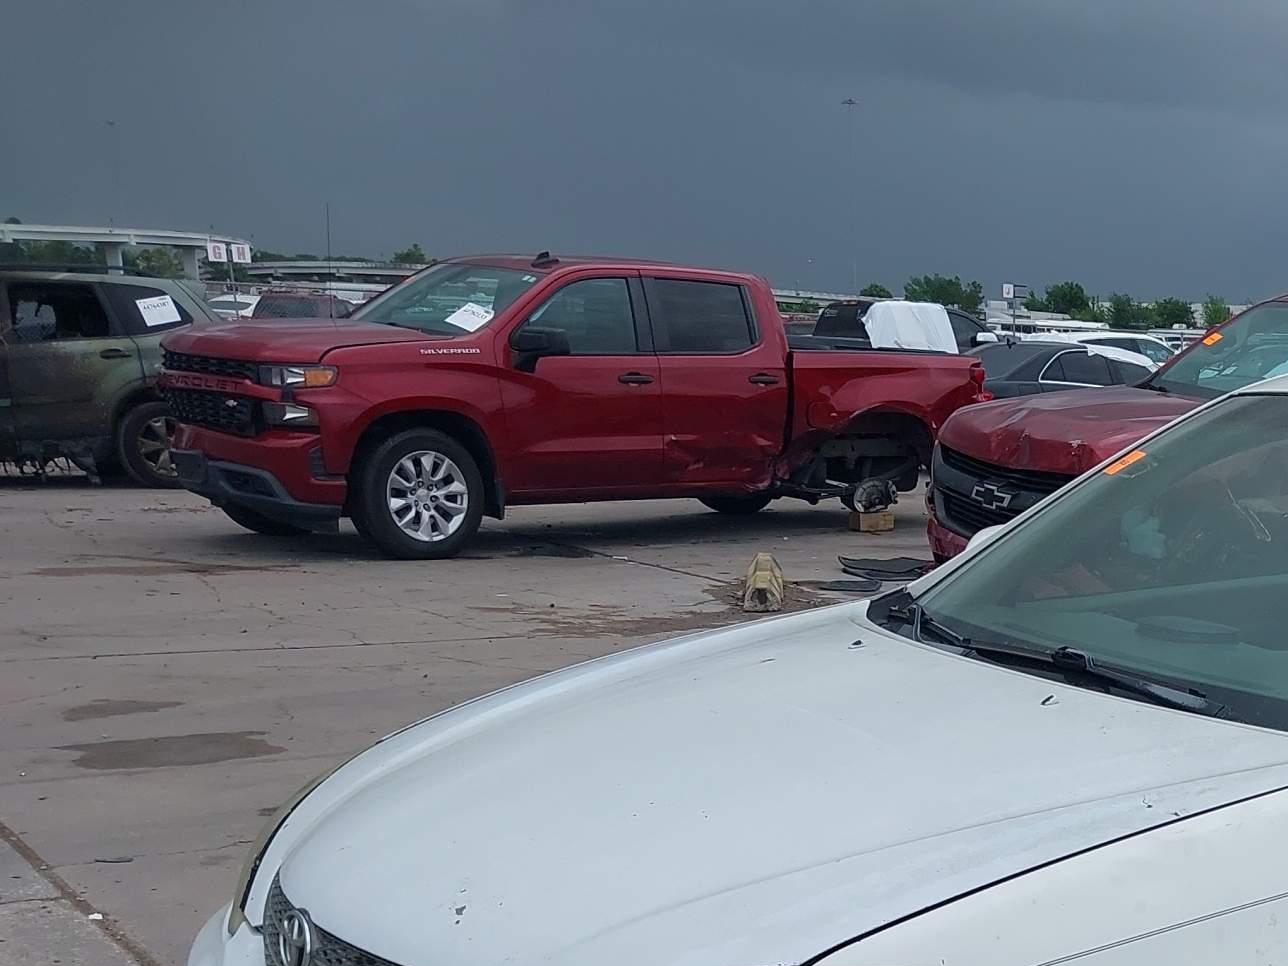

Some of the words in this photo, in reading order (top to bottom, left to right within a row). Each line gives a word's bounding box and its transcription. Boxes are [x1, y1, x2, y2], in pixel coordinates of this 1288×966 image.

[212, 245, 222, 260] G
[236, 246, 246, 261] H
[167, 374, 244, 391] EVROLET
